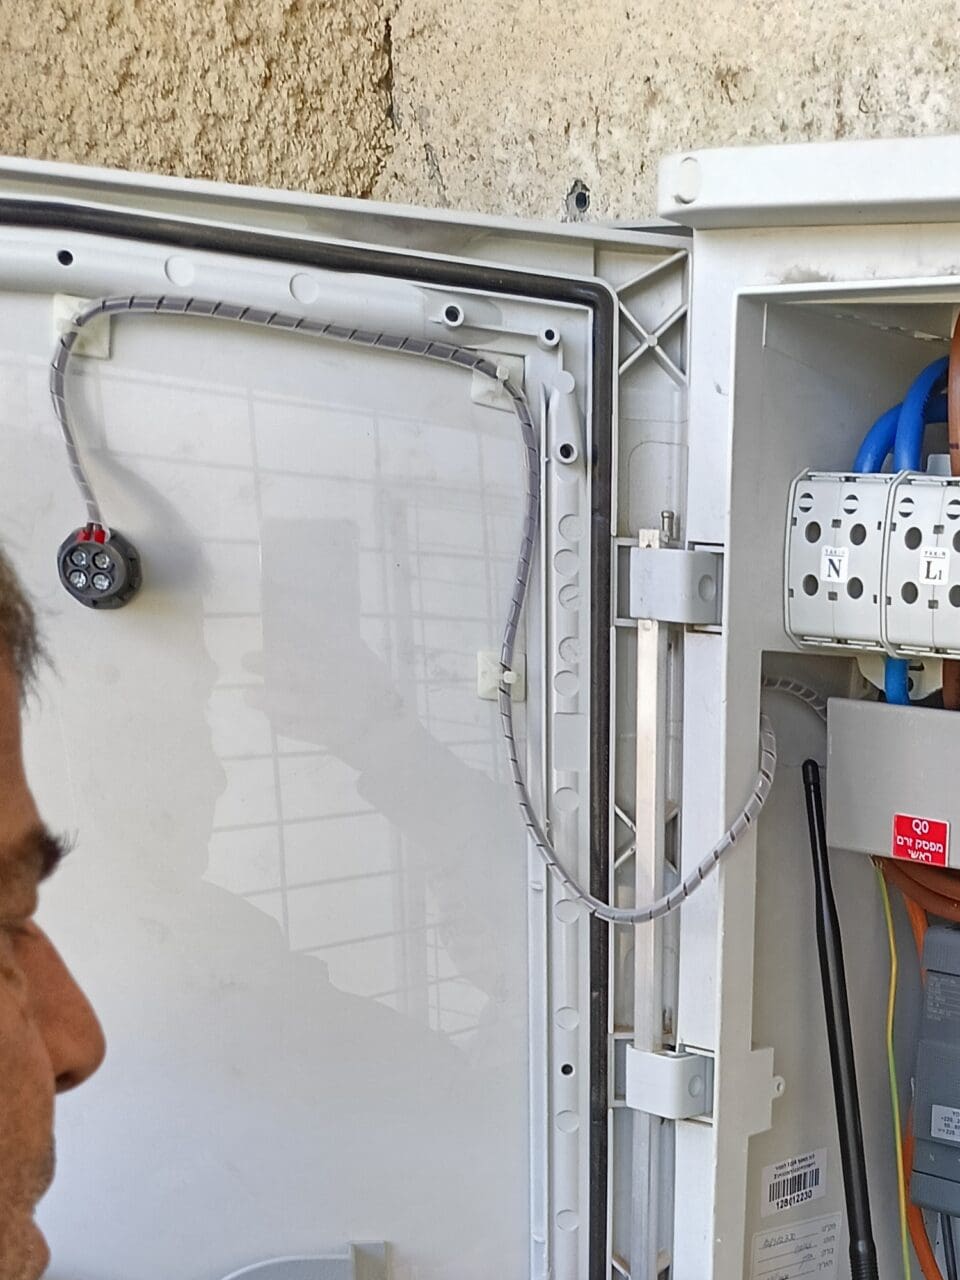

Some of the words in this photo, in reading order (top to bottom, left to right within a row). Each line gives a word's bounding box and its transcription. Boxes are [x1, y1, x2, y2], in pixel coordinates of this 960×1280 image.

[827, 558, 842, 578] N
[925, 561, 942, 580] L1
[896, 836, 913, 847] זרם
[915, 839, 944, 853] מפסק
[907, 849, 932, 862] ראשי
